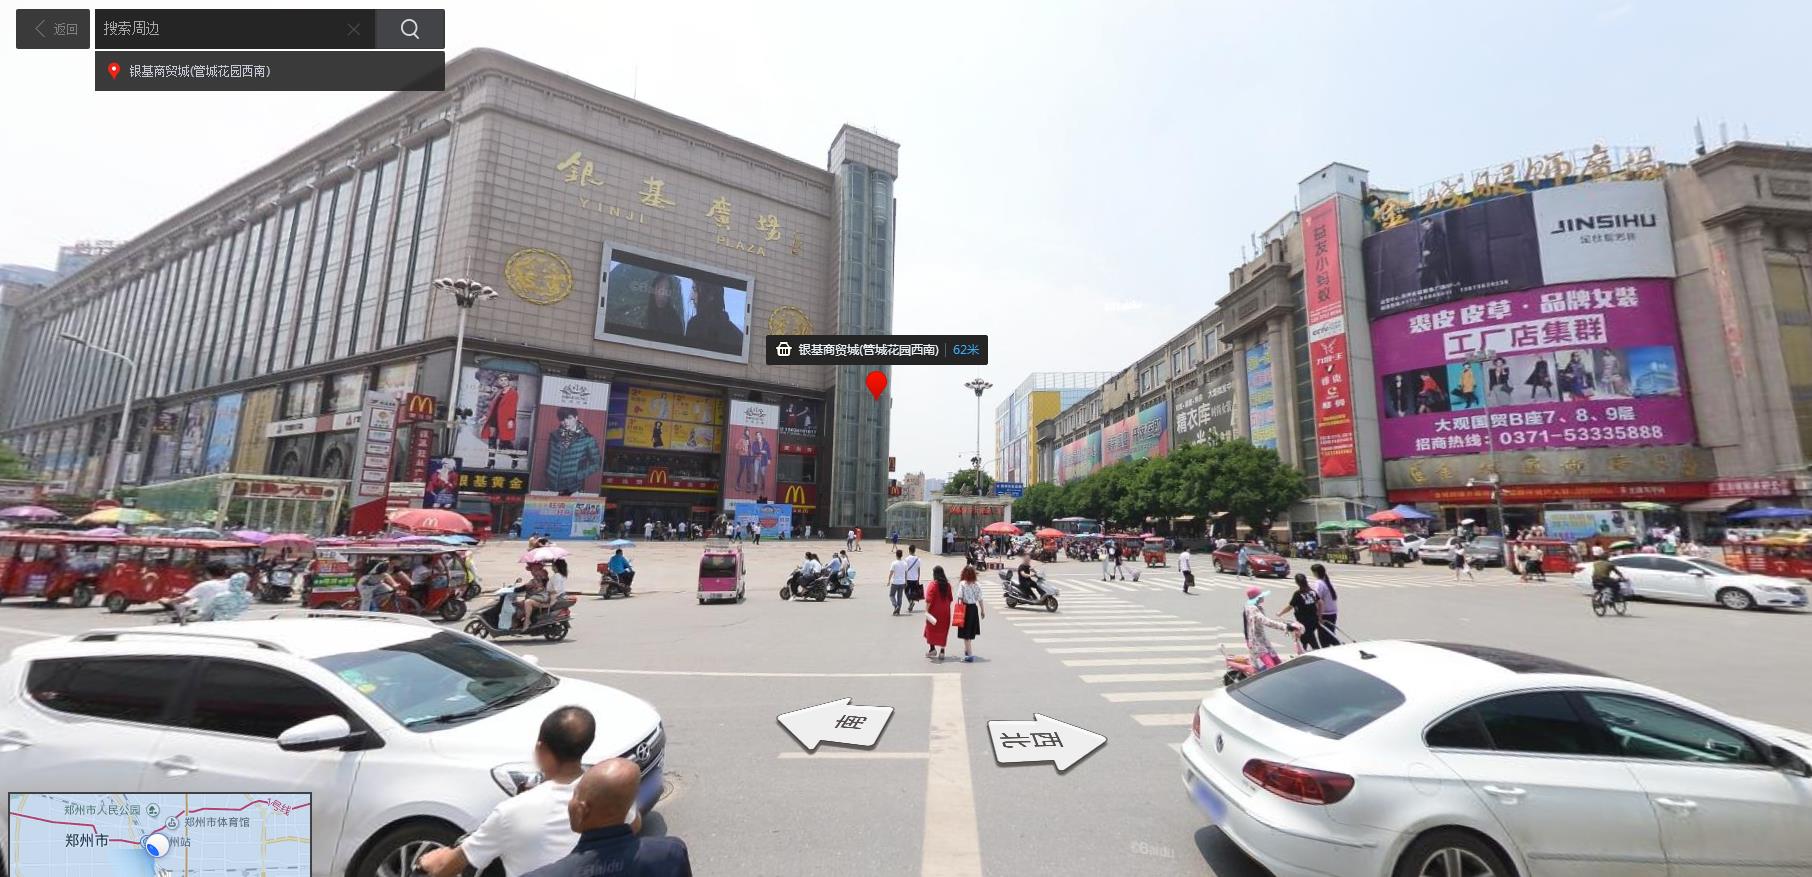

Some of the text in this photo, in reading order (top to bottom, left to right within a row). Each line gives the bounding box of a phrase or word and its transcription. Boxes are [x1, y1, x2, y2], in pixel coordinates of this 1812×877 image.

[580, 196, 646, 225] YINJI
[715, 234, 767, 258] PLAZA
[1550, 213, 1657, 235] JINSIHU
[1448, 316, 1603, 355] 工厂店集群
[1434, 406, 1635, 432] 大观国贸B座7、8、9层
